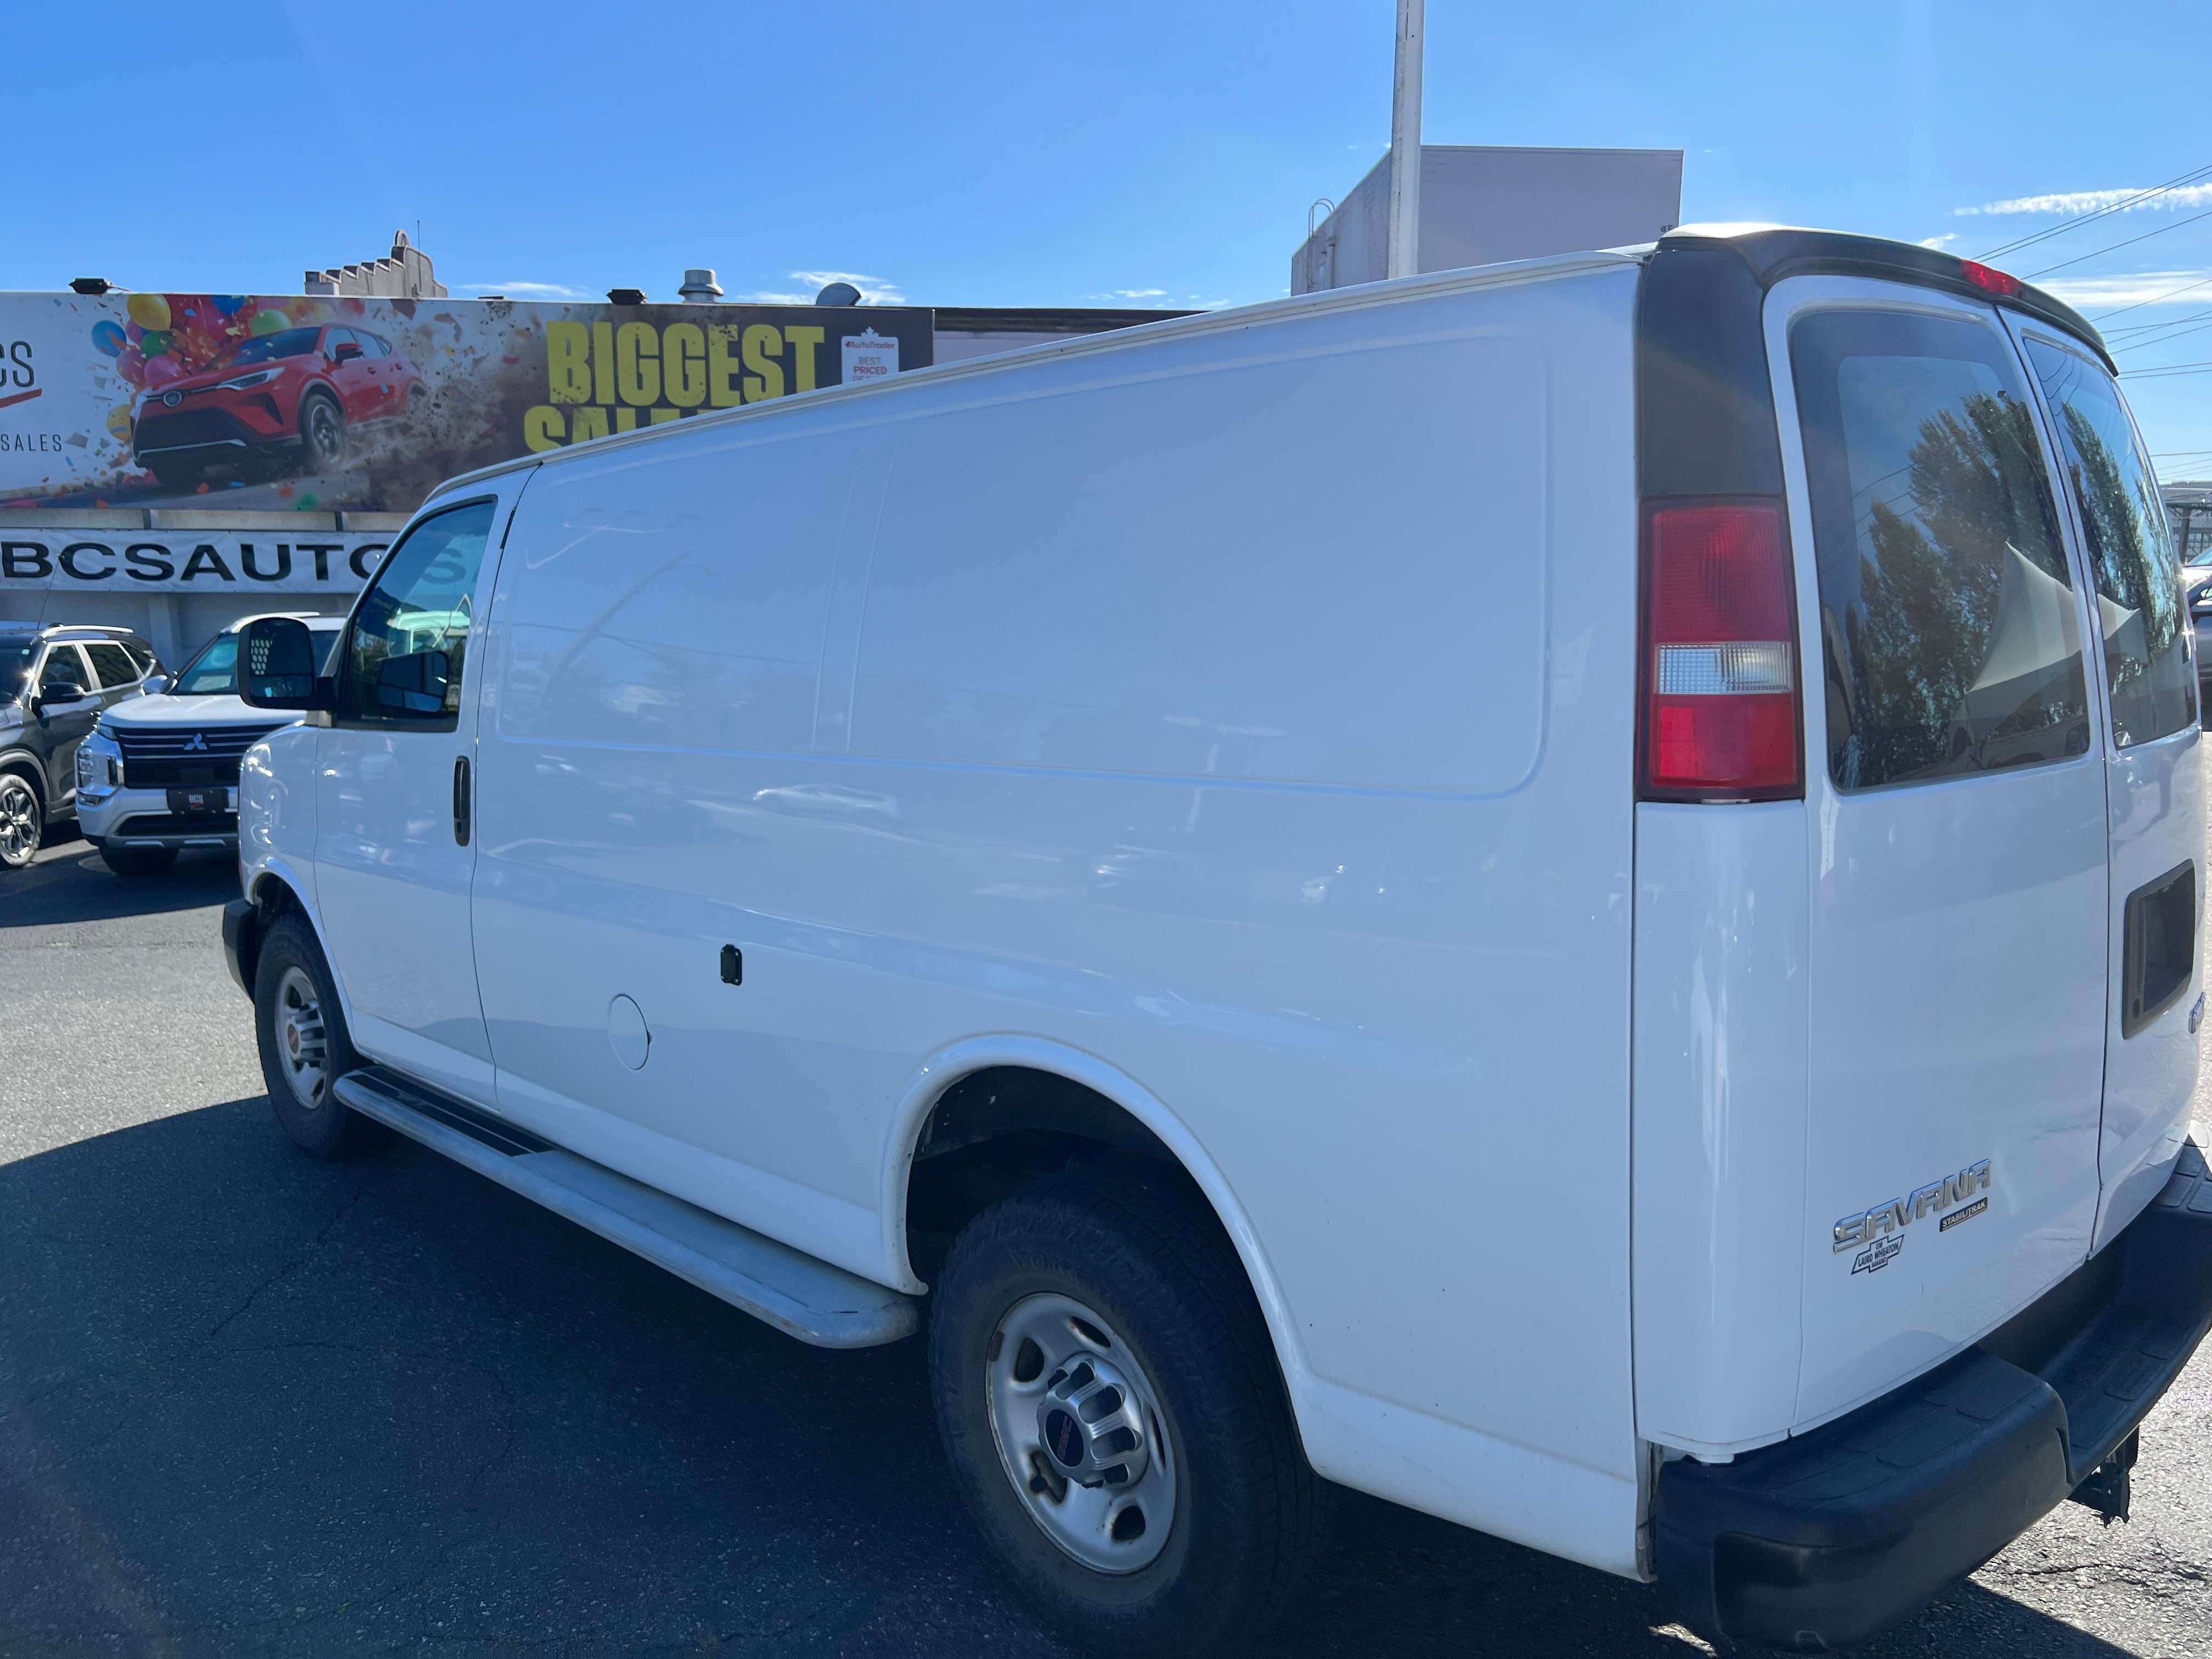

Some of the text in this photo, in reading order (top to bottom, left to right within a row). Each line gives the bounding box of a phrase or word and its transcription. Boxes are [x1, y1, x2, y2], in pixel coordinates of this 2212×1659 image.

[546, 321, 825, 407] BIGGEST
[853, 366, 887, 375] PRICED
[859, 357, 882, 365] BEST
[1, 433, 62, 452] SALES
[1833, 1158, 1992, 1253] SAVANA
[1942, 1200, 1986, 1228] STABILITRAK
[1858, 1241, 1899, 1267] LAIRD WHEATON
[1057, 1415, 1073, 1460] GMC
